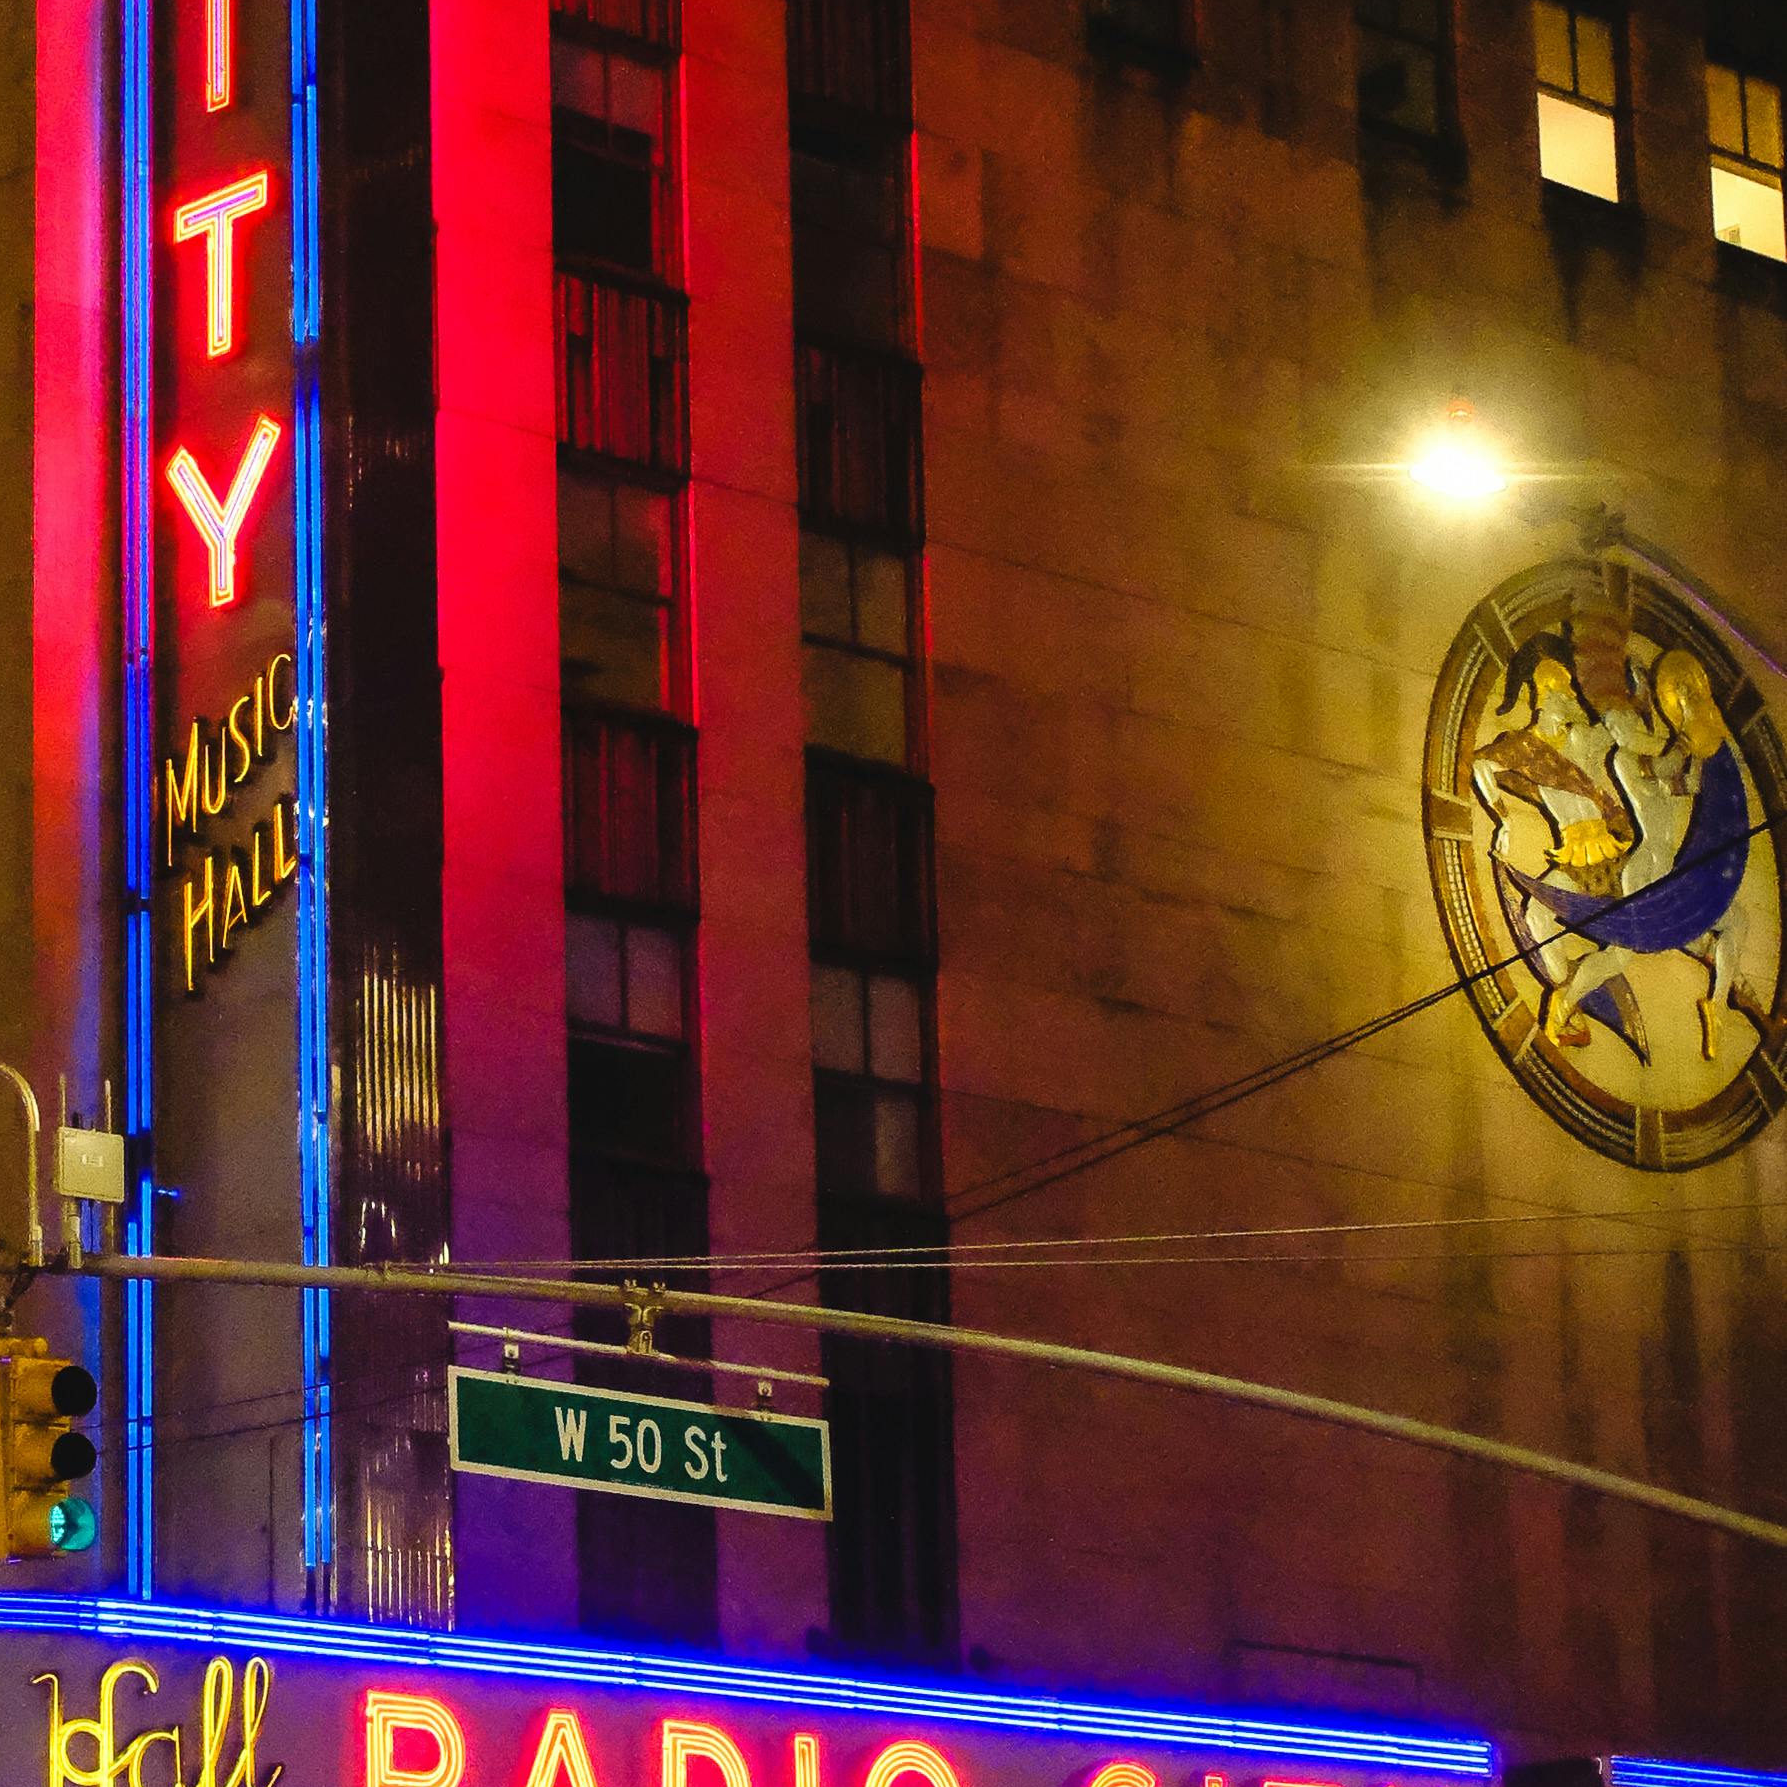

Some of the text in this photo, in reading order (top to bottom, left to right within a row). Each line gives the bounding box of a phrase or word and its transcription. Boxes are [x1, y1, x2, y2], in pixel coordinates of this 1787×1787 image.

[166, 653, 294, 867] MUSIC
[183, 803, 296, 991] HALL
[555, 1406, 729, 1483] W 50 St
